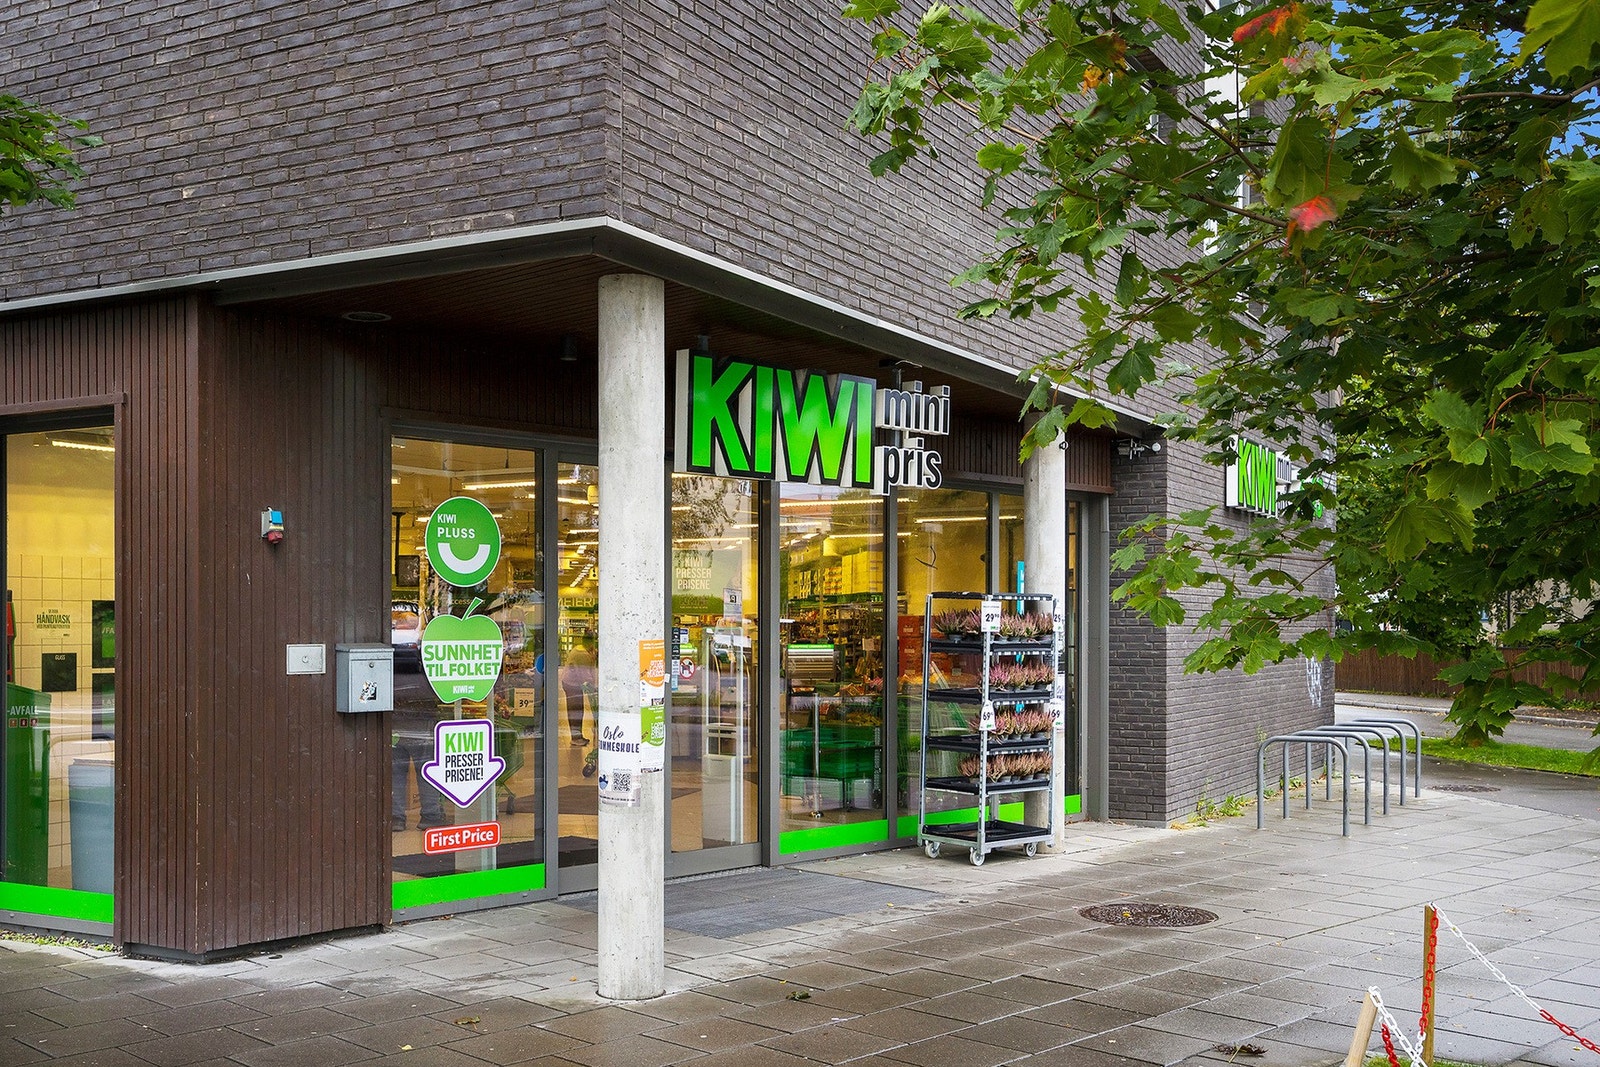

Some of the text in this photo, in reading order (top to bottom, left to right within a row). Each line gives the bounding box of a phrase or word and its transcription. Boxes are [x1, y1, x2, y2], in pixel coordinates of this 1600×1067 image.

[884, 380, 950, 435] mini
[688, 352, 875, 486] KIWI
[883, 438, 941, 495] pris
[1238, 438, 1275, 513] KIWI
[437, 513, 457, 524] KIWI
[437, 527, 476, 539] PLUSS
[676, 568, 711, 578] PRESSER
[677, 579, 710, 590] PRISENE
[36, 611, 71, 624] HÅNDVASK
[423, 644, 502, 662] SUNNHET
[426, 662, 500, 677] TIL FOLKET
[452, 685, 467, 694] KIWI
[603, 726, 624, 741] Oslo
[445, 732, 484, 753] KIWI
[445, 753, 484, 768] PRESSER
[445, 767, 484, 783] PRISENE!
[430, 828, 494, 848] First Price
